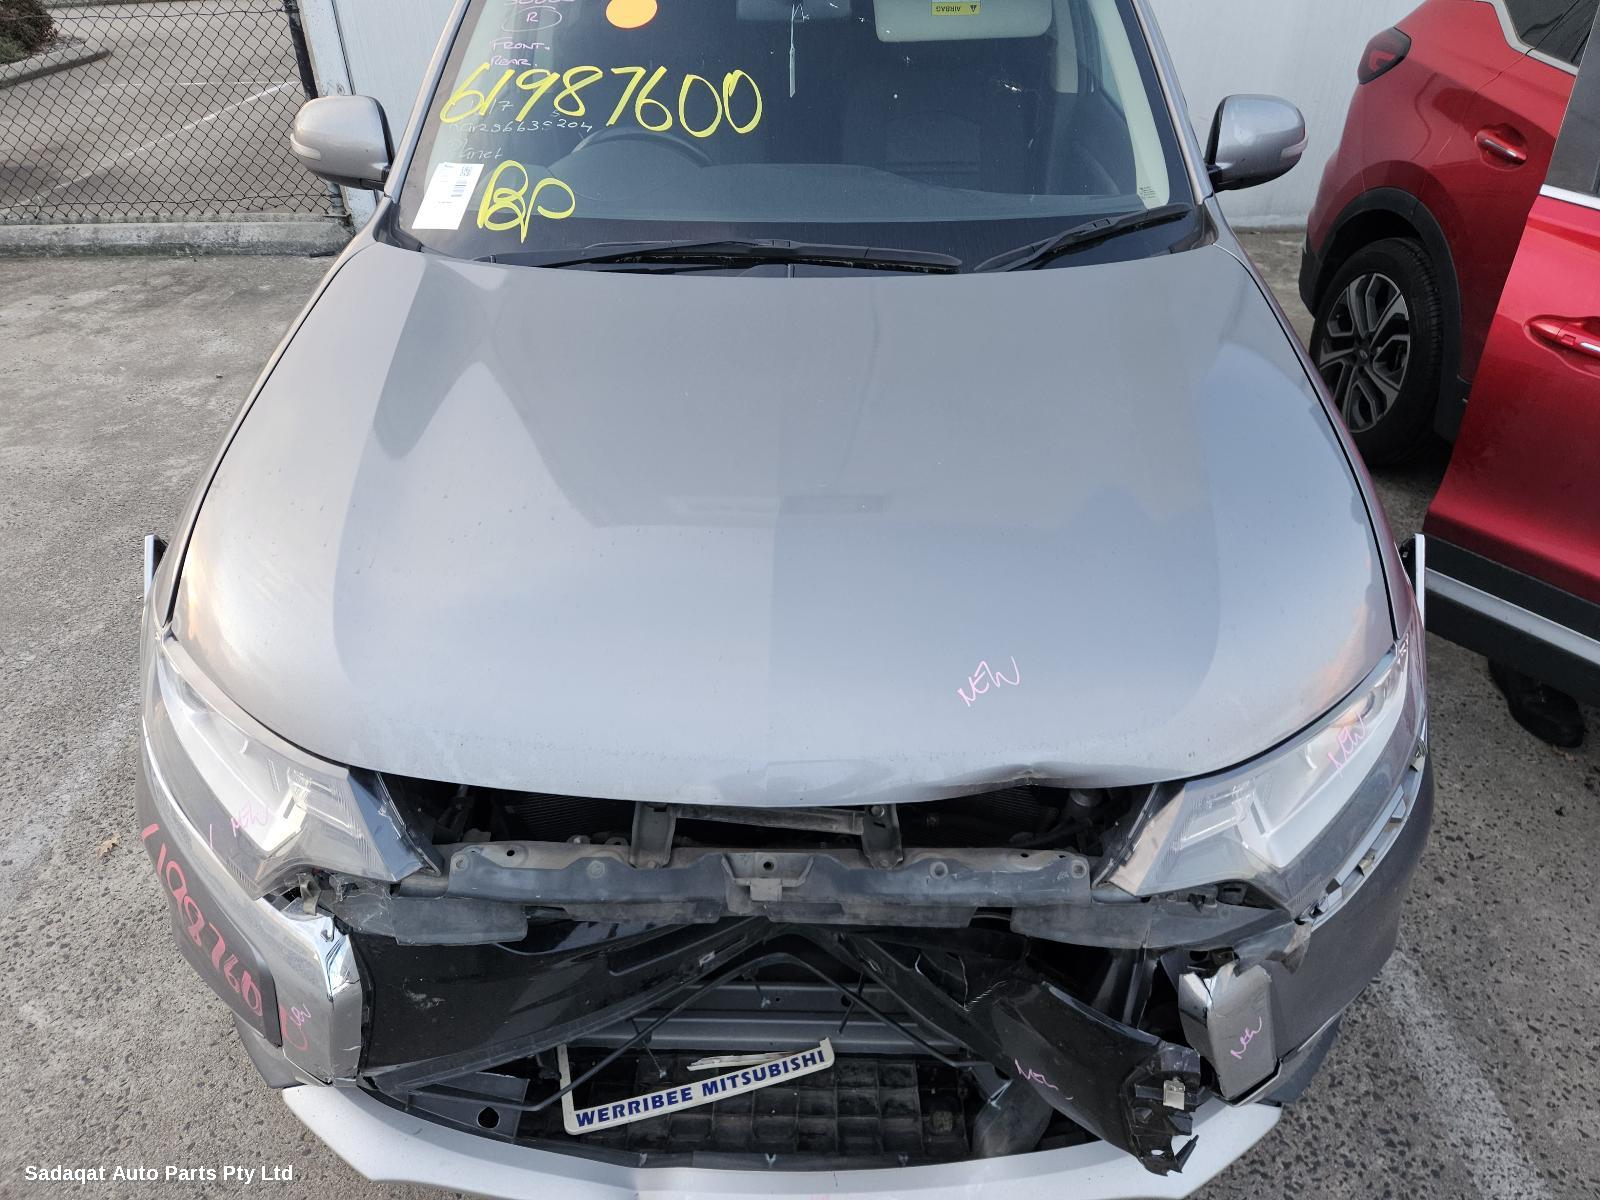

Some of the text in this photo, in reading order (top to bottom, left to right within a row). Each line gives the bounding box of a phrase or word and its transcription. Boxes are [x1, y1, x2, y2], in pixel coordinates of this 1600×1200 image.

[440, 62, 763, 138] 61987600
[575, 1048, 826, 1128] WERRIBEE MITSUBISHI
